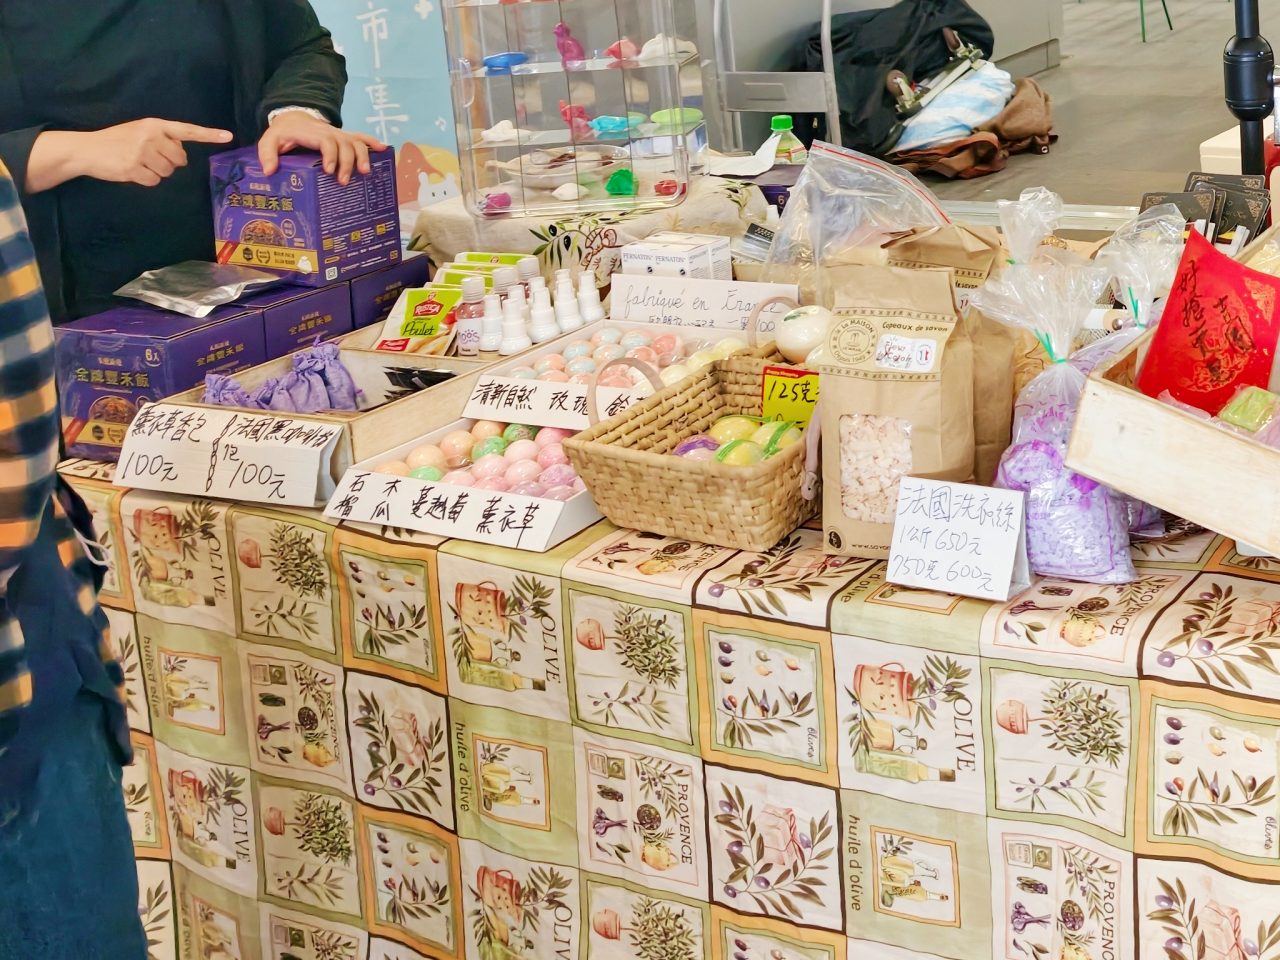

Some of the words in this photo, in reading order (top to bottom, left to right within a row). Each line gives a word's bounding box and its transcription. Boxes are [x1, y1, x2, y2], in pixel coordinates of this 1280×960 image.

[692, 296, 710, 311] en
[768, 380, 819, 403] 125克
[121, 451, 179, 482] 100元
[229, 460, 286, 499] 100元
[935, 526, 984, 556] 650元
[946, 560, 994, 592] 600元
[540, 615, 561, 685] OLIVE
[950, 696, 977, 774] OLIVE
[231, 803, 251, 864] OLIVE
[677, 783, 694, 866] PROVENCE
[848, 814, 861, 855] huile
[848, 858, 862, 912] d'olive
